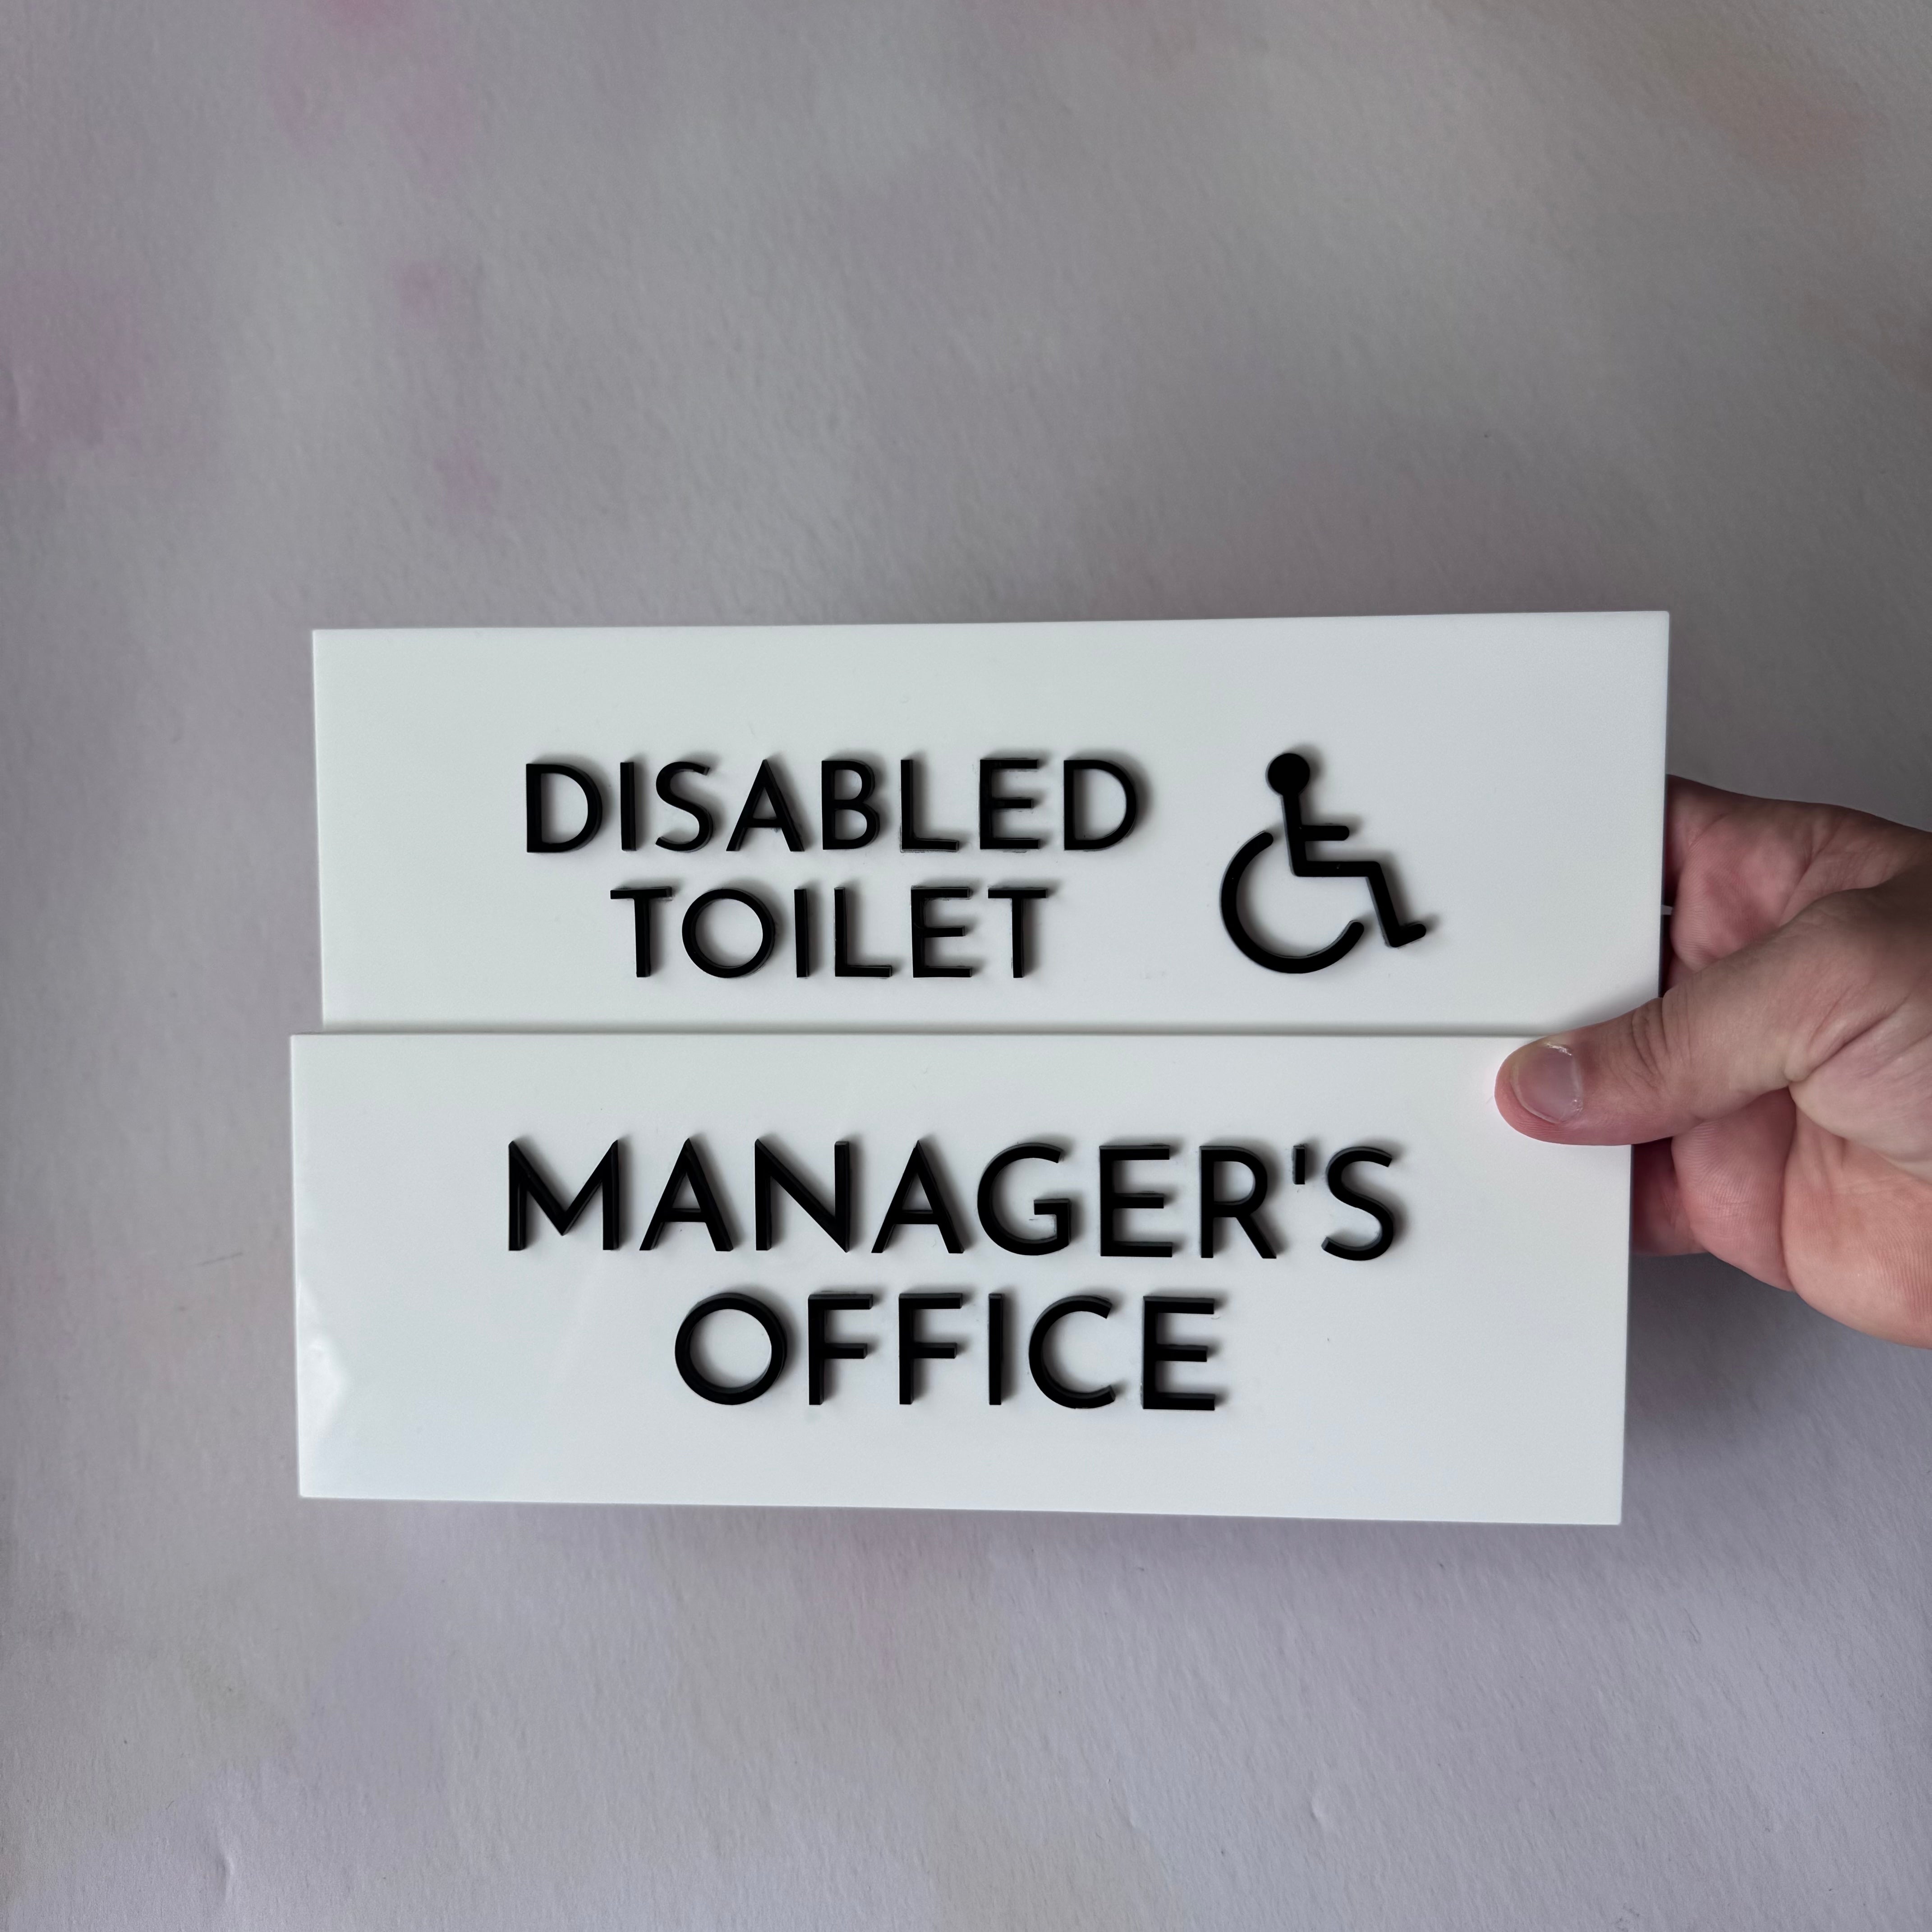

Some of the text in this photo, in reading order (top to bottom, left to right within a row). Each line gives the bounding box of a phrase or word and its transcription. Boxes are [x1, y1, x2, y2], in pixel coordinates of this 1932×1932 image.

[526, 758, 1146, 853] DISABLED
[611, 886, 1052, 979] TOILET
[508, 1138, 1402, 1261] MANAGER'S
[675, 1293, 1221, 1411] OFFICE
